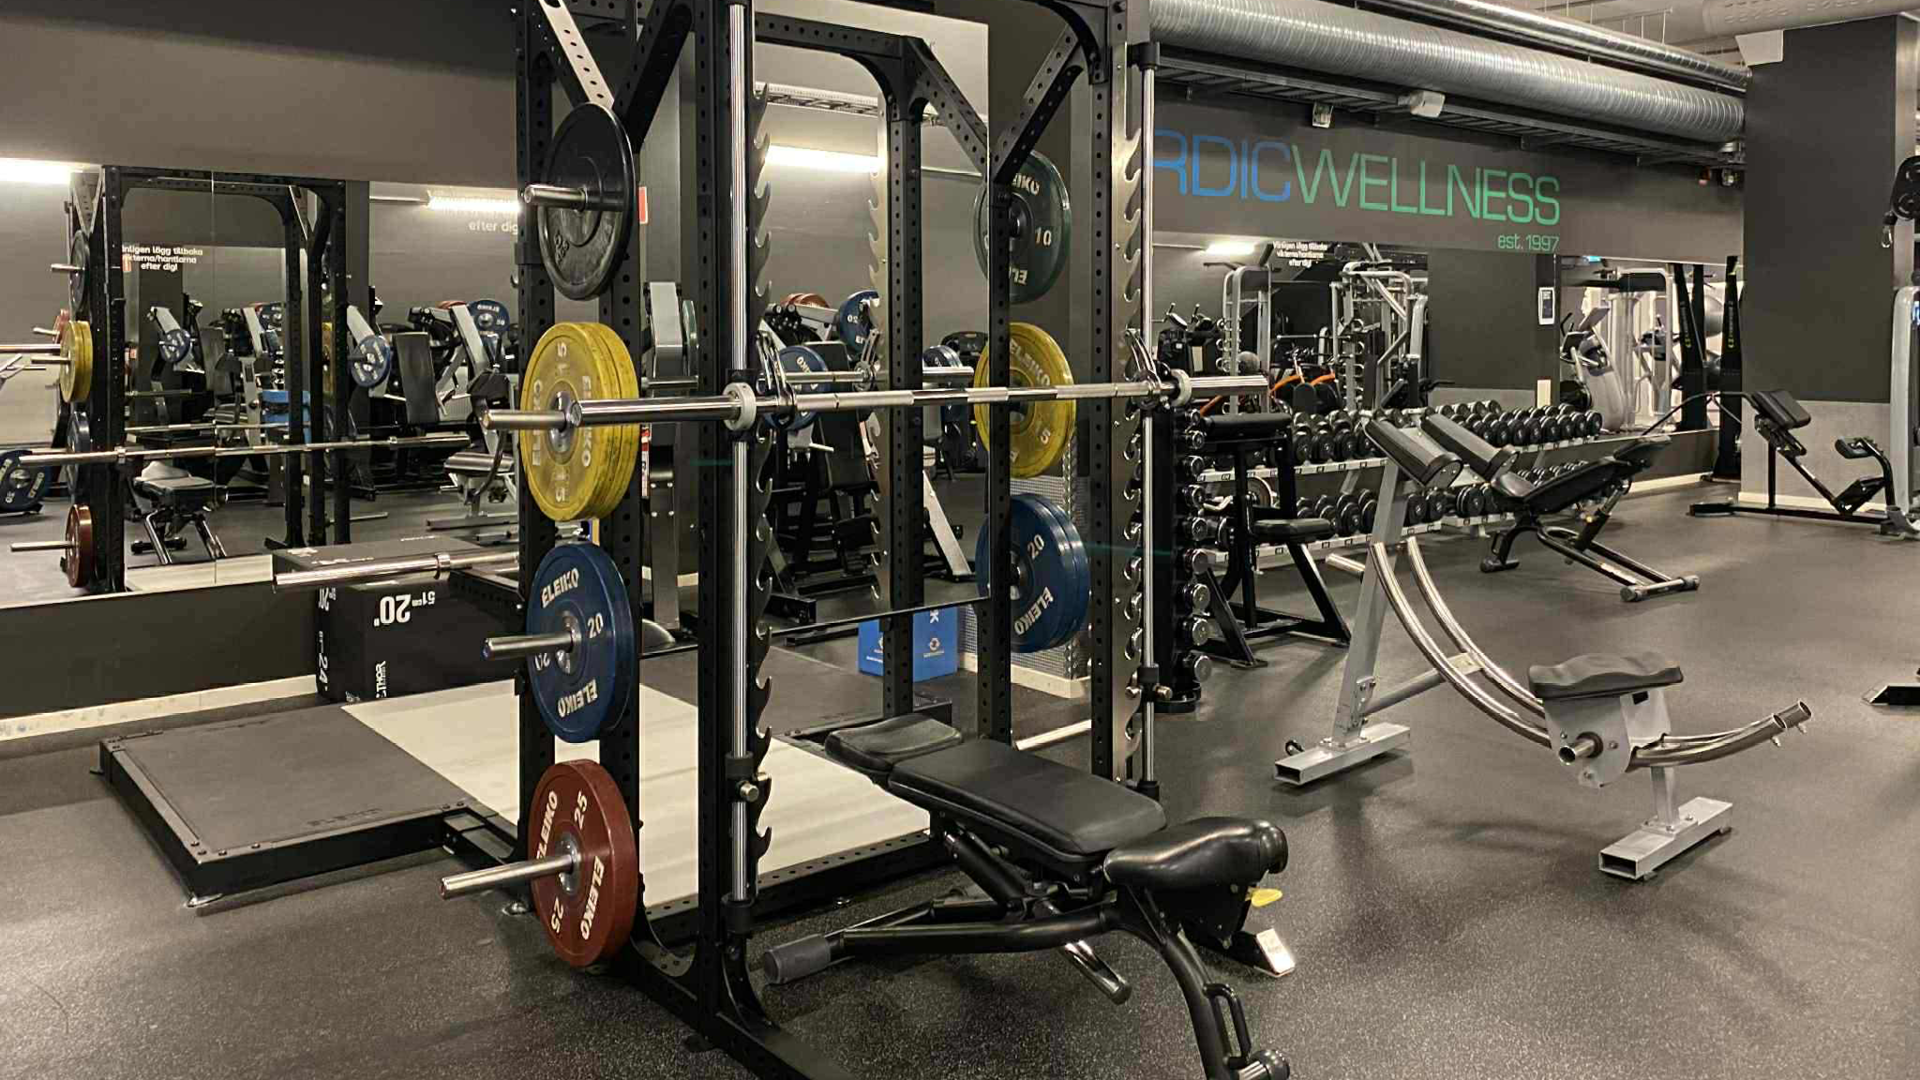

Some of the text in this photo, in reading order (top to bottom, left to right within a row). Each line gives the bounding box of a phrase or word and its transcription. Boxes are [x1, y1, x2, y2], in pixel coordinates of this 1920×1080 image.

[1034, 226, 1052, 246] 10
[1497, 232, 1560, 253] est. 1997
[1027, 533, 1046, 560] 20
[541, 567, 580, 609] ELEIKO
[587, 612, 604, 639] 20
[1014, 586, 1054, 636] ELEIKO
[557, 679, 599, 718] ELEIKO
[573, 790, 588, 830] 25
[551, 897, 565, 933] 25
[580, 855, 605, 941] ELEIKO
